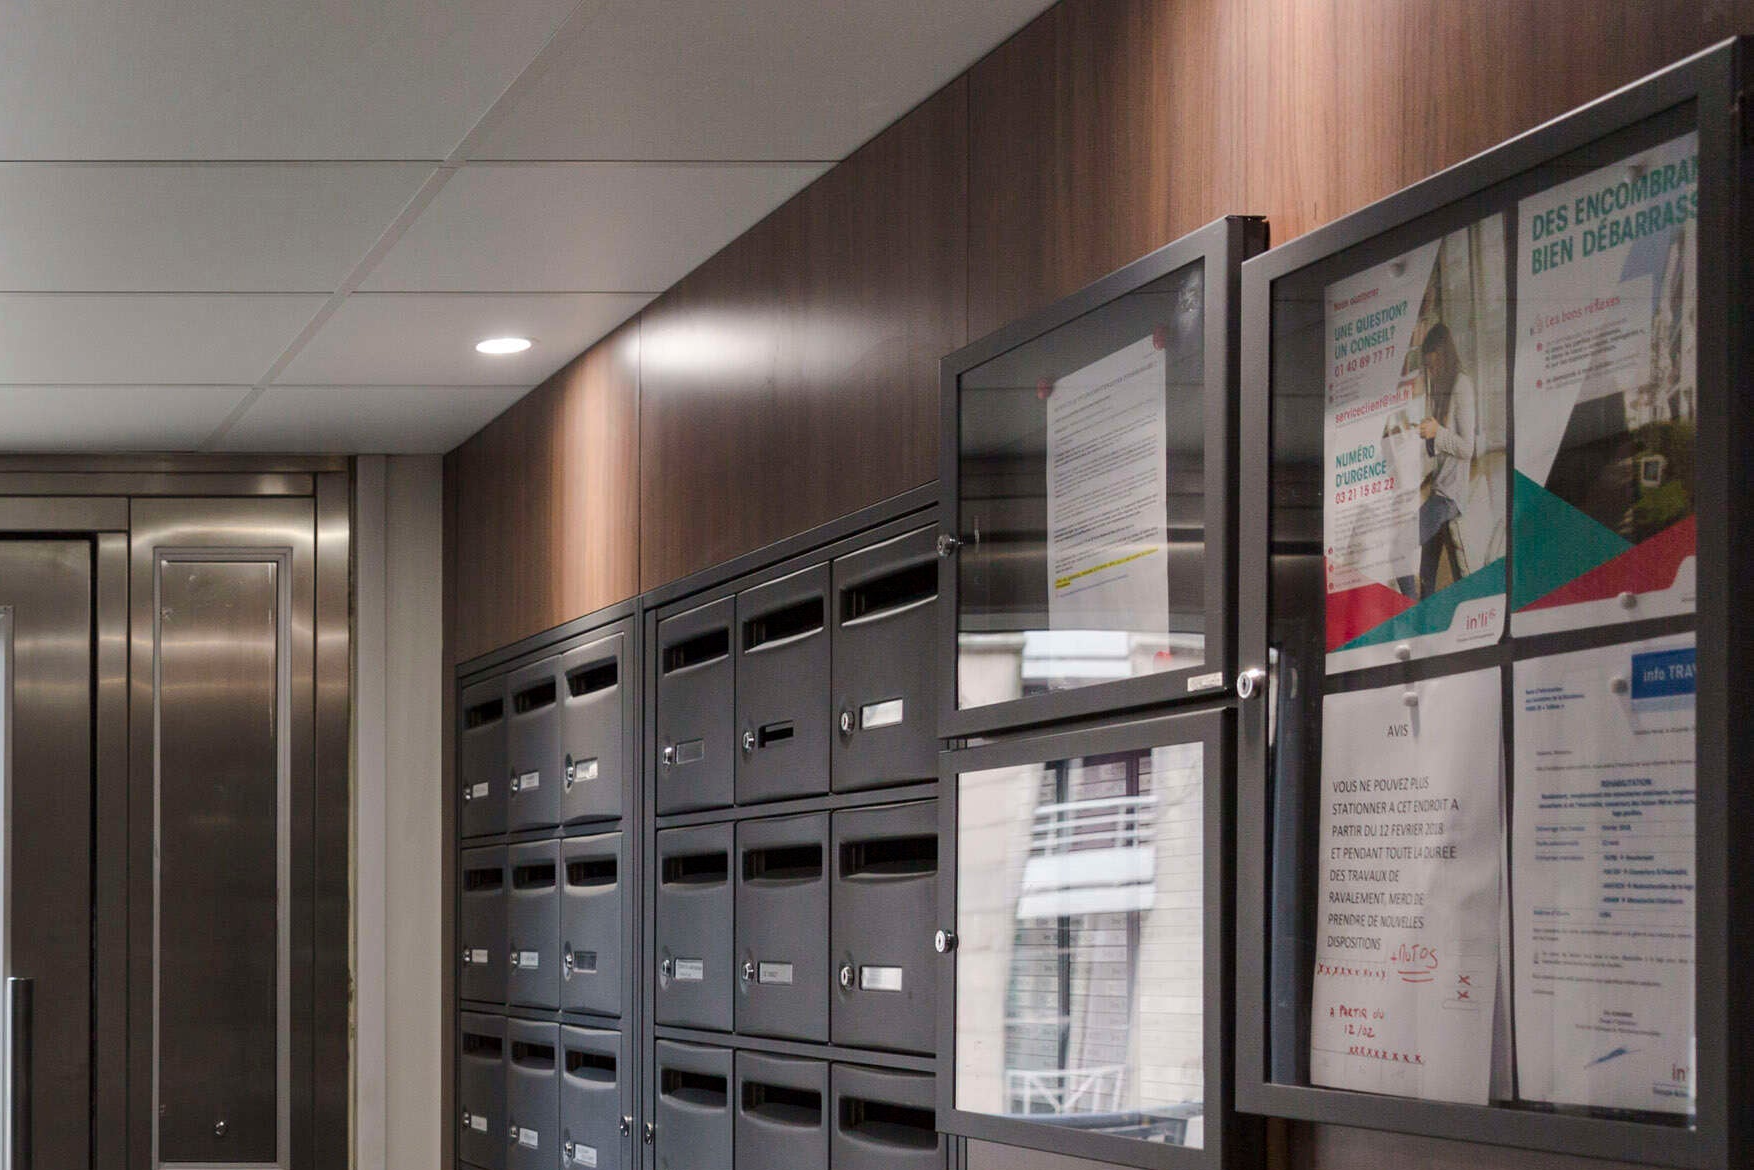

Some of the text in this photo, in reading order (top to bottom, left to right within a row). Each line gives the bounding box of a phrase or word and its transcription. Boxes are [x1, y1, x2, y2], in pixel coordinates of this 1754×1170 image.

[1532, 204, 1568, 242] DES
[1532, 236, 1573, 276] BIEN
[1334, 323, 1353, 341] UNE
[1335, 343, 1348, 360] UN
[1336, 444, 1375, 469] NUMÉRO
[1336, 459, 1387, 488] D'URGENCE
[1643, 665, 1664, 682] info
[1387, 724, 1409, 737] AVIS
[1333, 776, 1429, 793] VOUS NE POUVEZ PLUS
[1332, 801, 1387, 816] STATIONNER
[1397, 800, 1413, 813] CET
[1414, 799, 1448, 812] ENDROIT
[1332, 825, 1362, 837] PARTIR
[1364, 825, 1377, 837] DU
[1379, 824, 1388, 836] 12
[1331, 847, 1342, 860] ET
[1343, 847, 1383, 860] PENDANT
[1386, 846, 1412, 859] TOUTE
[1414, 847, 1422, 859] LA
[1329, 869, 1399, 883] DES TRAVAUX DE
[1414, 893, 1424, 905] DE
[1328, 913, 1424, 929] PRENDRE DE NOUVELLES
[1327, 935, 1381, 950] DISPOSITIONS
